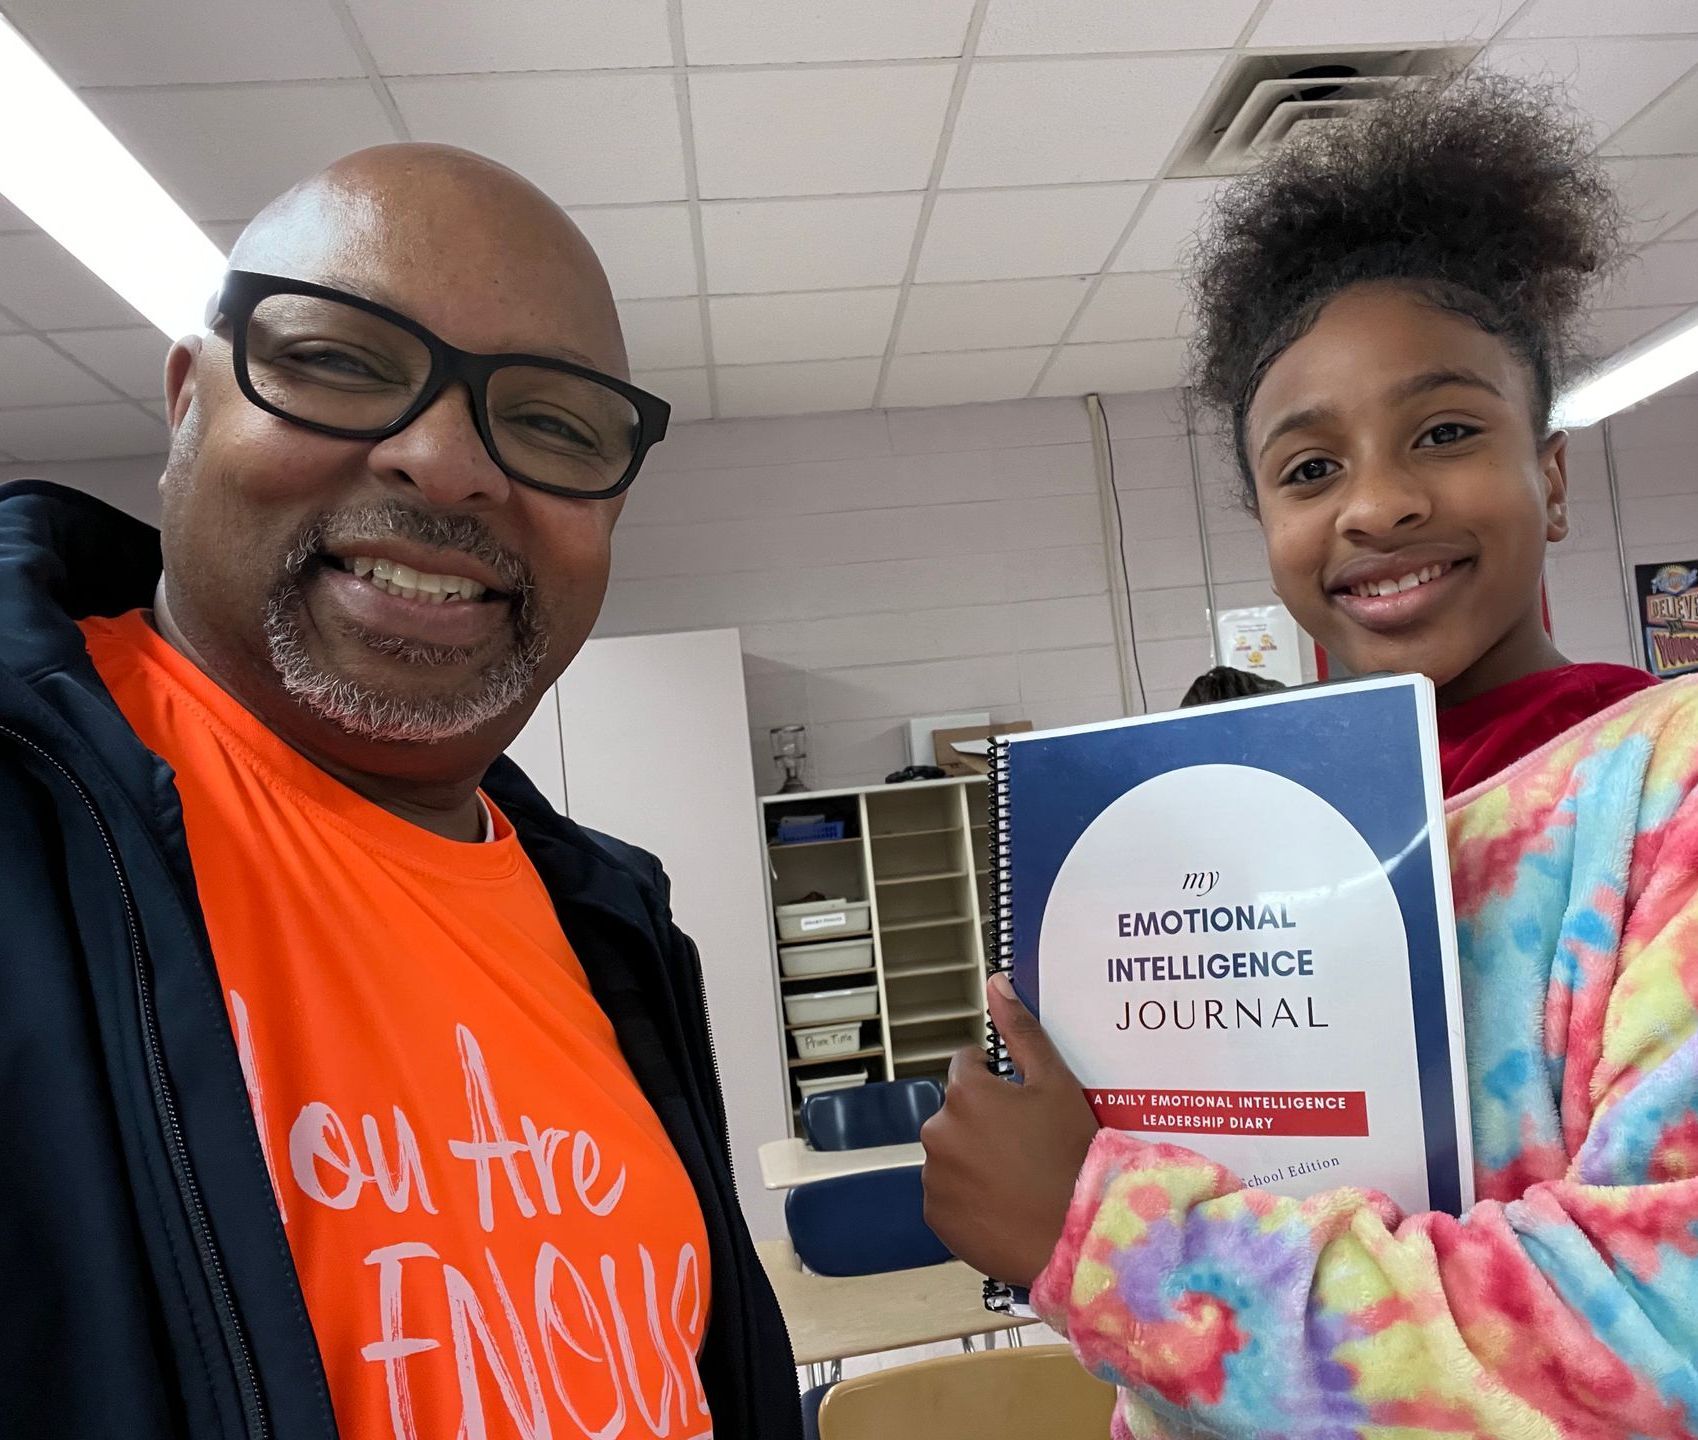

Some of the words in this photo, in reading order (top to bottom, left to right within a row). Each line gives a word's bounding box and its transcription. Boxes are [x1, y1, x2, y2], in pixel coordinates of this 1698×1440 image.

[1182, 870, 1220, 897] my
[1118, 903, 1297, 937] EMOTIONAL
[1107, 949, 1314, 983] INTELLIGENCE
[1116, 996, 1329, 1031] JOURNAL
[1094, 1094, 1103, 1105] A
[1108, 1094, 1146, 1107] DAILY
[1151, 1095, 1234, 1109] EMOTIONAL
[1238, 1097, 1346, 1110] INTELLIGENCE
[447, 1022, 627, 1232] Are
[1143, 1114, 1225, 1129] LEADERSHIP
[1229, 1117, 1274, 1130] DIARY
[1288, 1157, 1341, 1178] Edition
